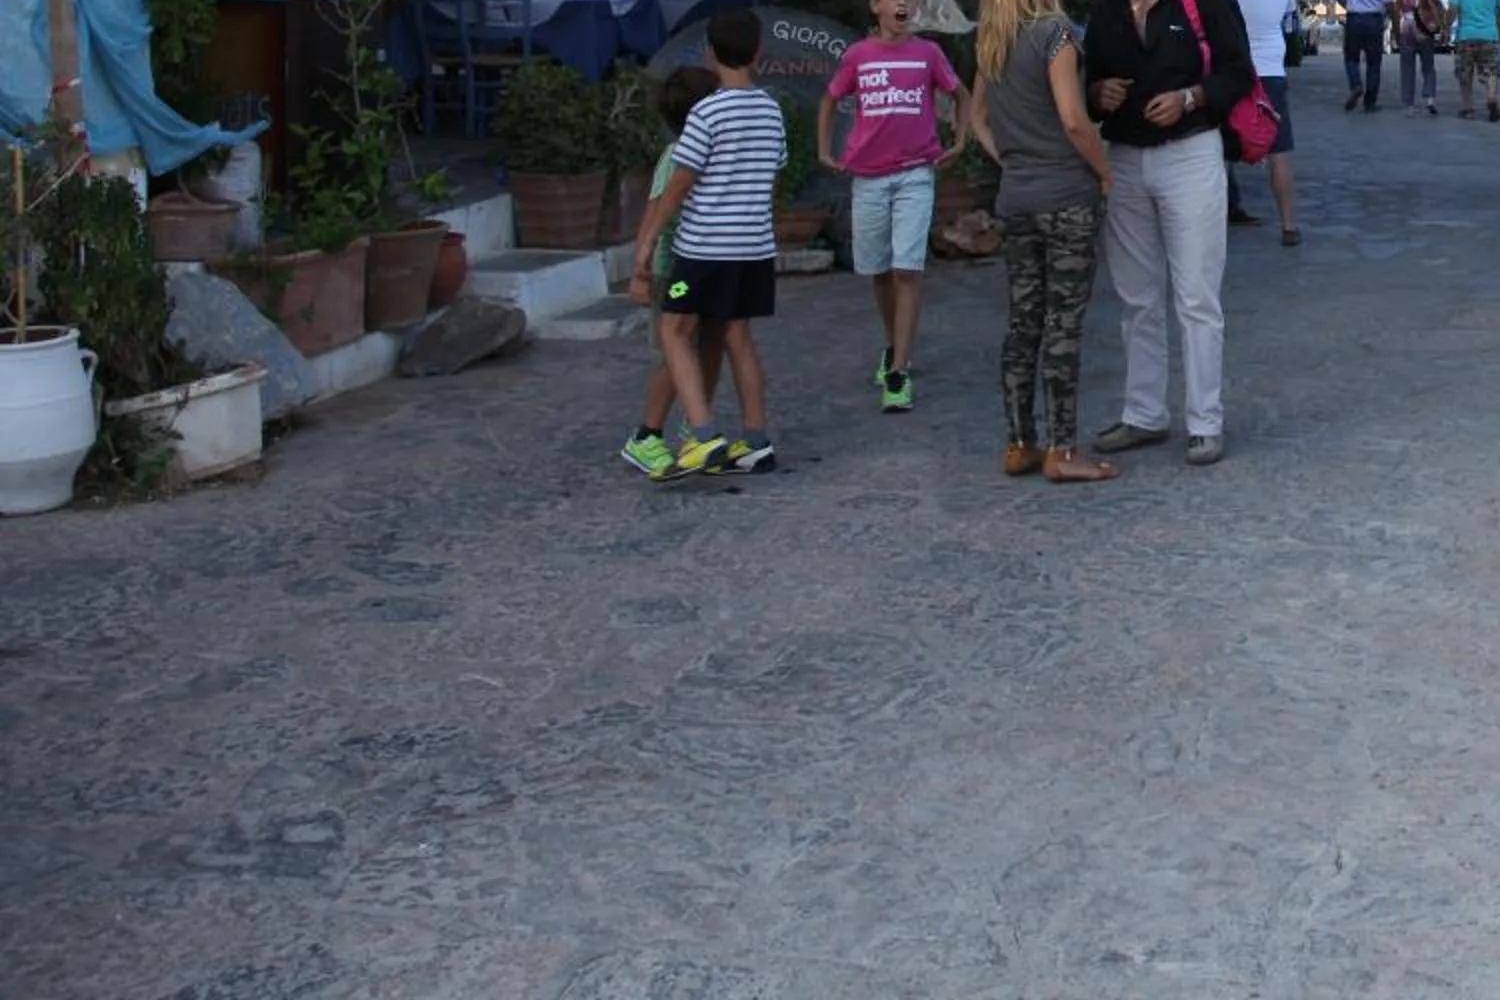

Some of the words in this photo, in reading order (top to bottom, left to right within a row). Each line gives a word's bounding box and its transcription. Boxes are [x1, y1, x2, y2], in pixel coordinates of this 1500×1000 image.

[773, 20, 846, 61] GIORG
[858, 69, 889, 88] not
[860, 86, 923, 107] perfect
